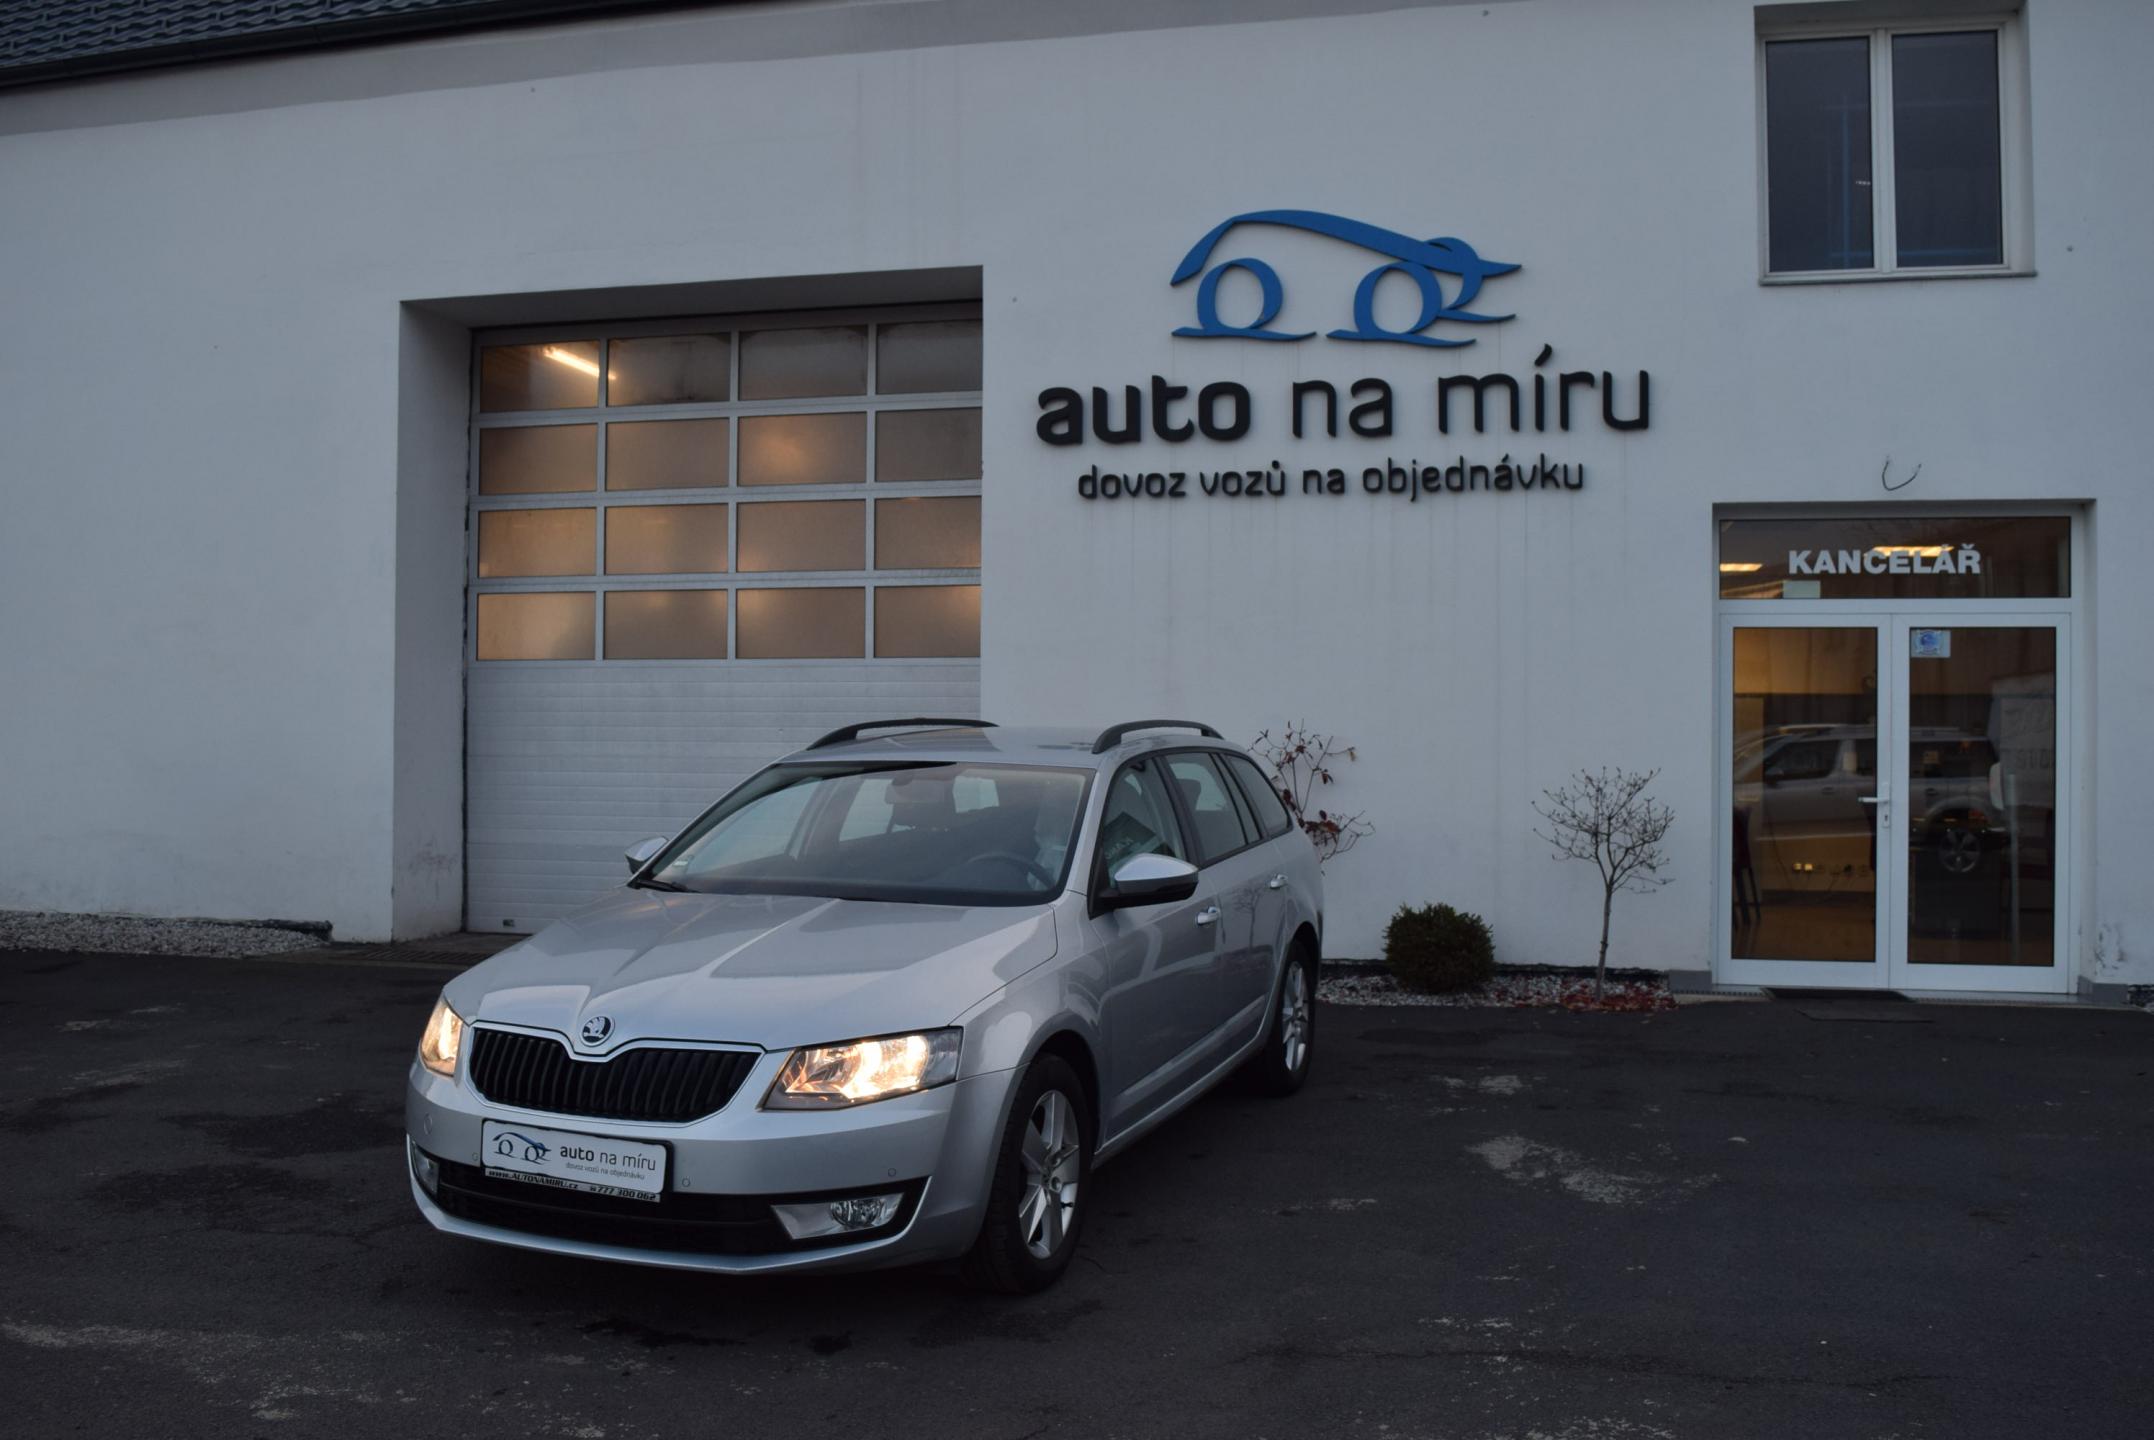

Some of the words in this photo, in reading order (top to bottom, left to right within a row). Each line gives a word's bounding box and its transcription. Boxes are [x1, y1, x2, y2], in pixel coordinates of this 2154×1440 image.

[1036, 375, 1252, 446] auto
[1292, 377, 1394, 440] na
[1437, 344, 1651, 436] míru
[1078, 464, 1187, 501] dovoz
[1199, 460, 1287, 499] vozů
[1302, 468, 1346, 497] na
[1362, 453, 1585, 503] objednávku
[560, 1146, 594, 1162] auto
[599, 1152, 617, 1165] na
[622, 1153, 656, 1171] míru
